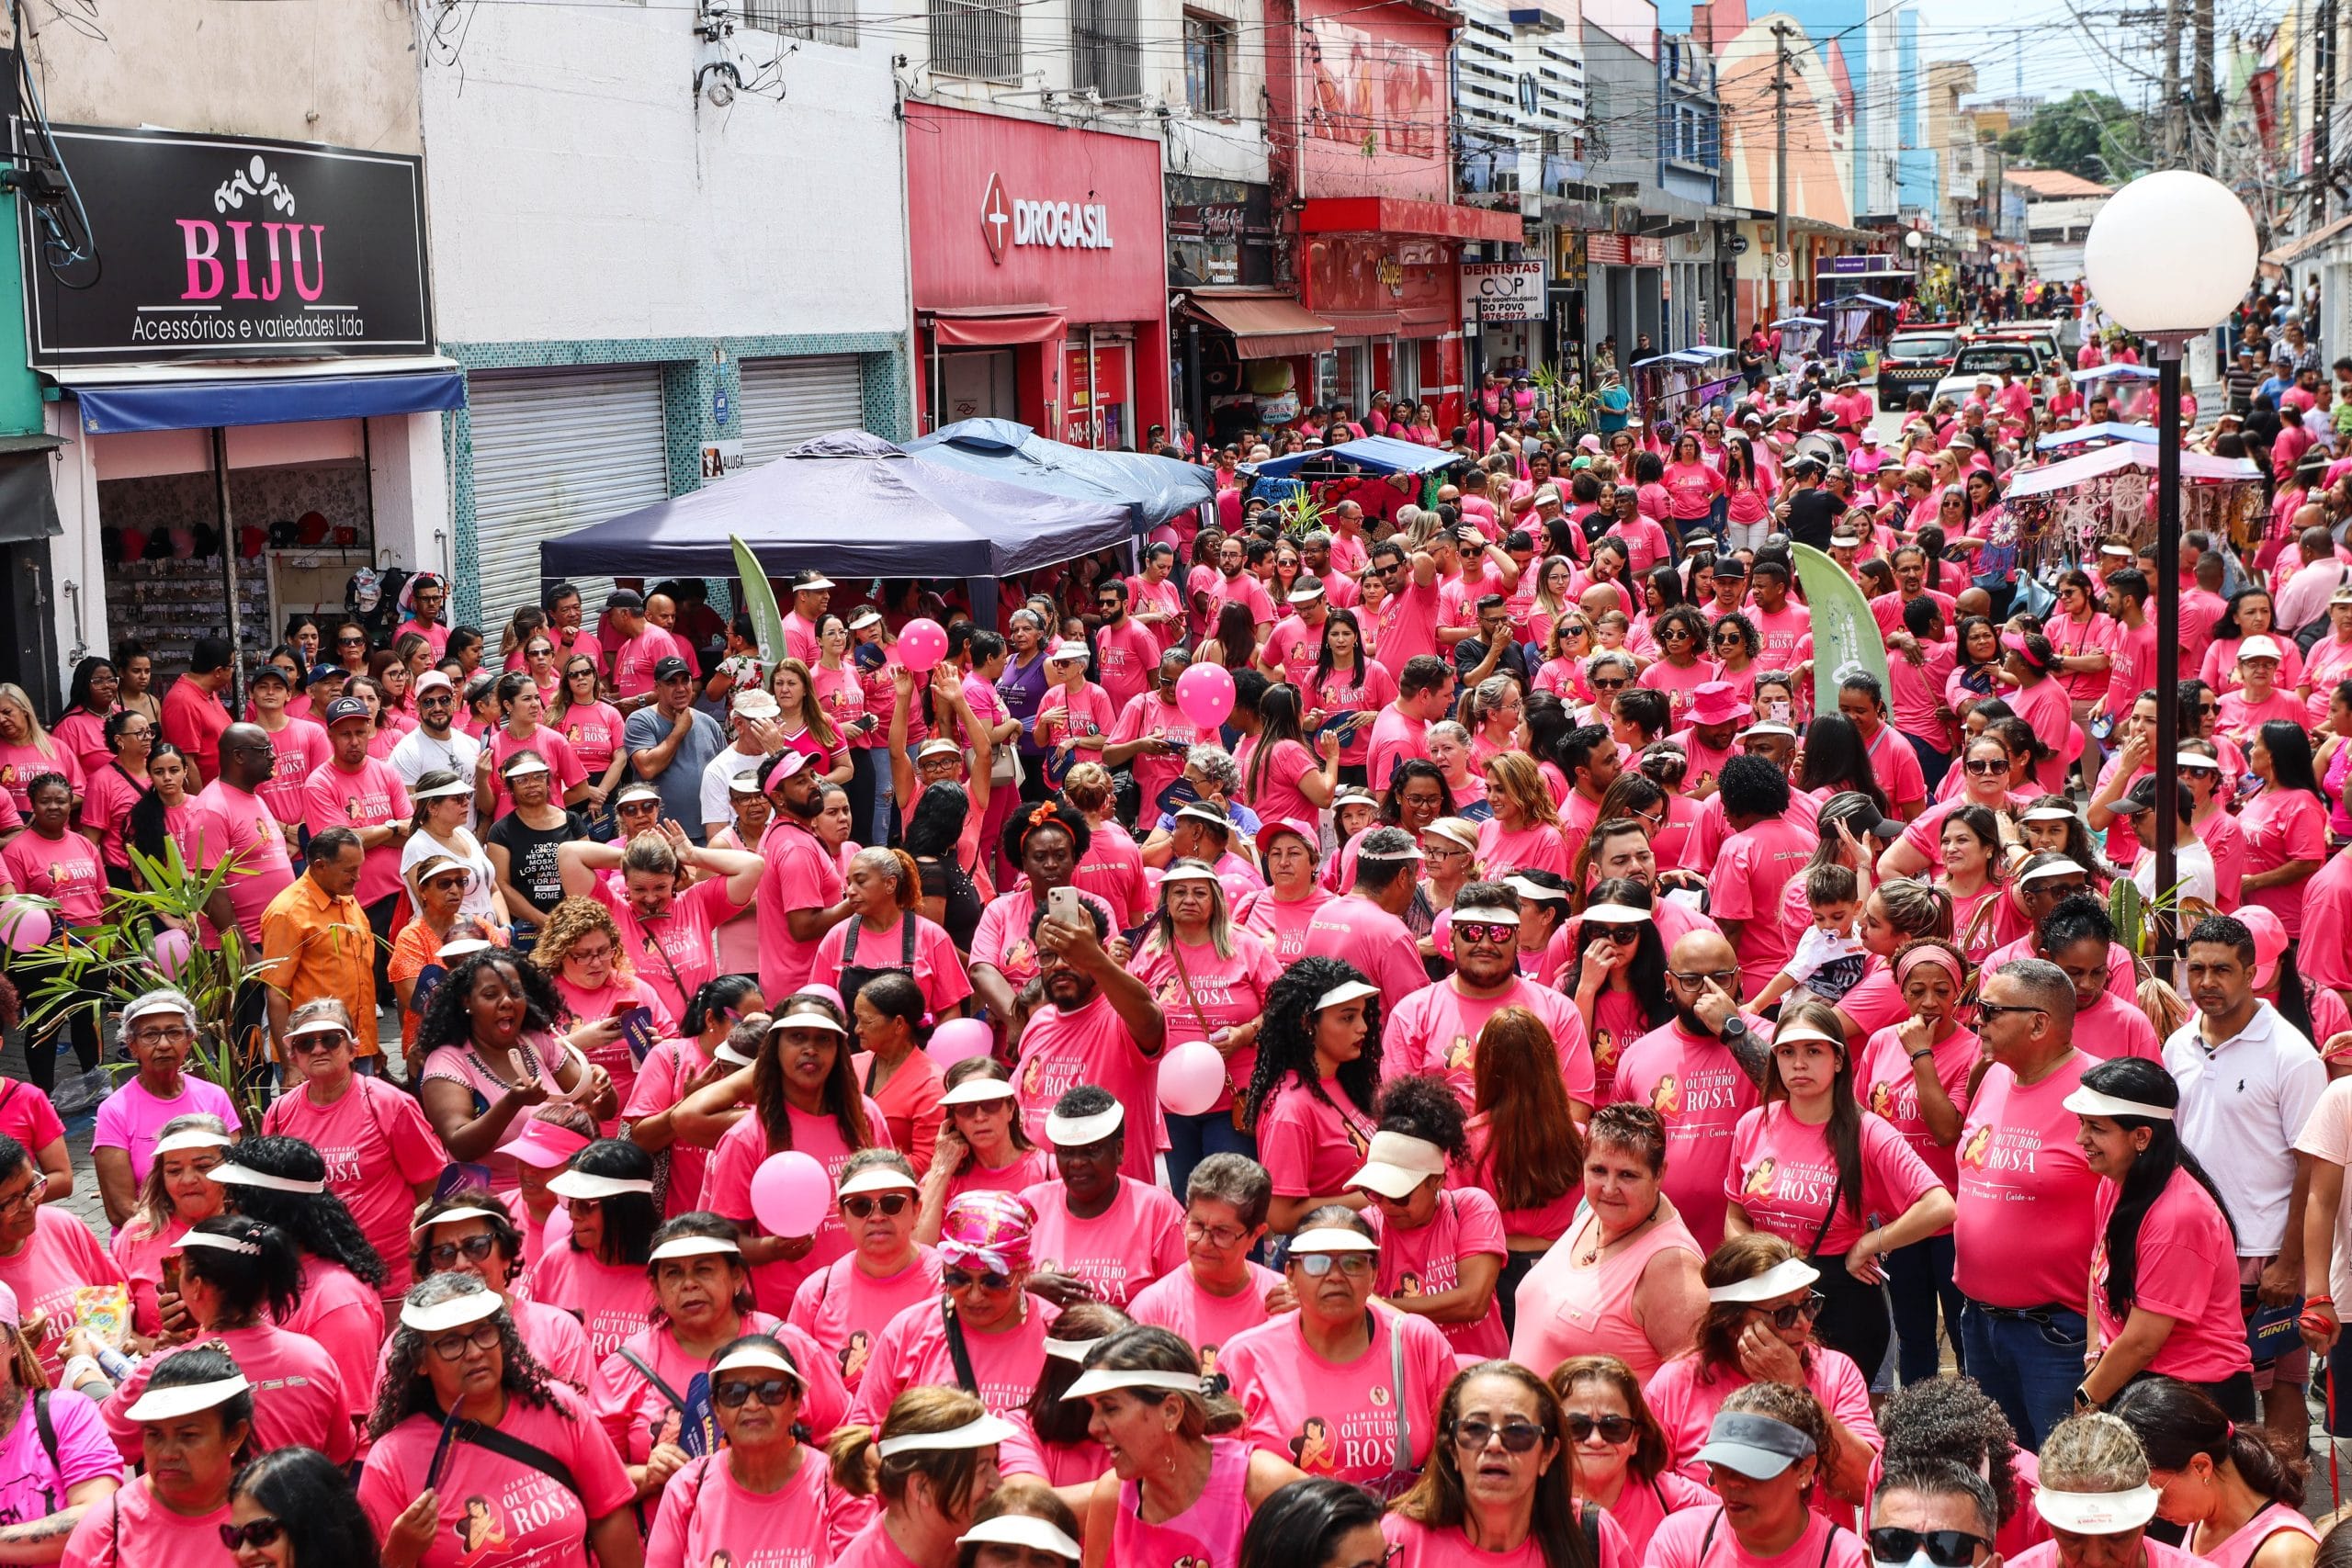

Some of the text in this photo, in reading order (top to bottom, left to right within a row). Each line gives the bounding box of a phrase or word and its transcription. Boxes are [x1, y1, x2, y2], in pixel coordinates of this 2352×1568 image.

[1013, 198, 1114, 249] DROGASIL
[175, 219, 325, 301] BIJU
[1464, 264, 1541, 275] DENTISTAS
[1498, 303, 1524, 311] POVO
[131, 311, 364, 341] Acessórios e variedades Ltda
[723, 455, 743, 469] ALUGA
[519, 865, 537, 876] LOS
[535, 892, 560, 900] ROME
[1685, 1075, 1736, 1090] OUTUBRO
[1686, 1087, 1736, 1111] ROSA
[1995, 1133, 2042, 1152] OUTUBRO
[1988, 1146, 2037, 1174] ROSA
[324, 1162, 363, 1184] OSA
[1782, 1168, 1838, 1186] OUTUBRO
[1778, 1179, 1834, 1208] ROSA
[2257, 1321, 2291, 1339] UNIP
[1344, 1438, 1396, 1469] ROS
